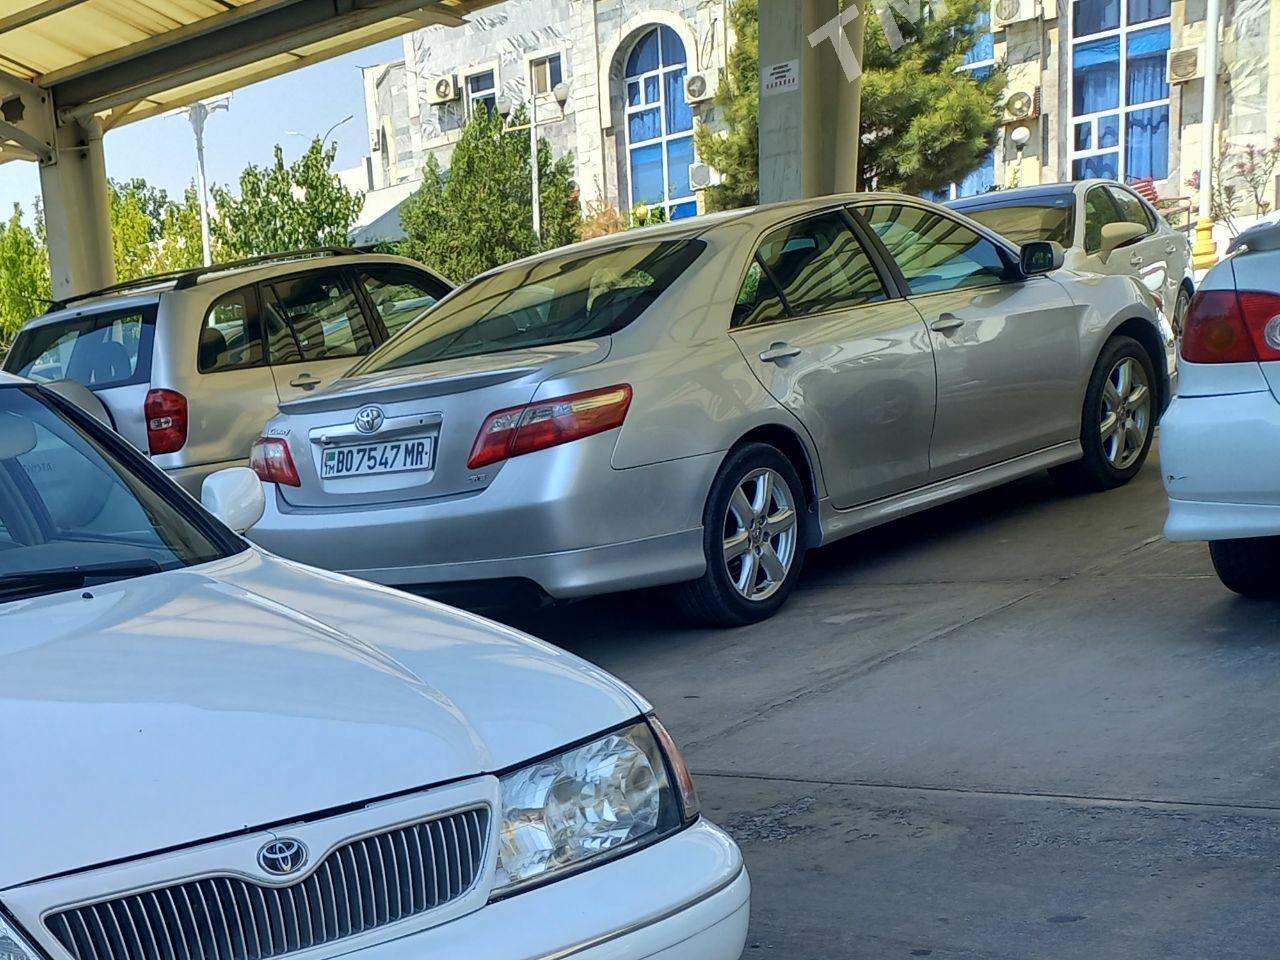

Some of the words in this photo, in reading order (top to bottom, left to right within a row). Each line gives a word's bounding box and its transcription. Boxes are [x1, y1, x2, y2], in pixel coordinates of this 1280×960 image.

[355, 444, 401, 472] 7547
[403, 441, 425, 467] MR
[324, 463, 335, 475] TM
